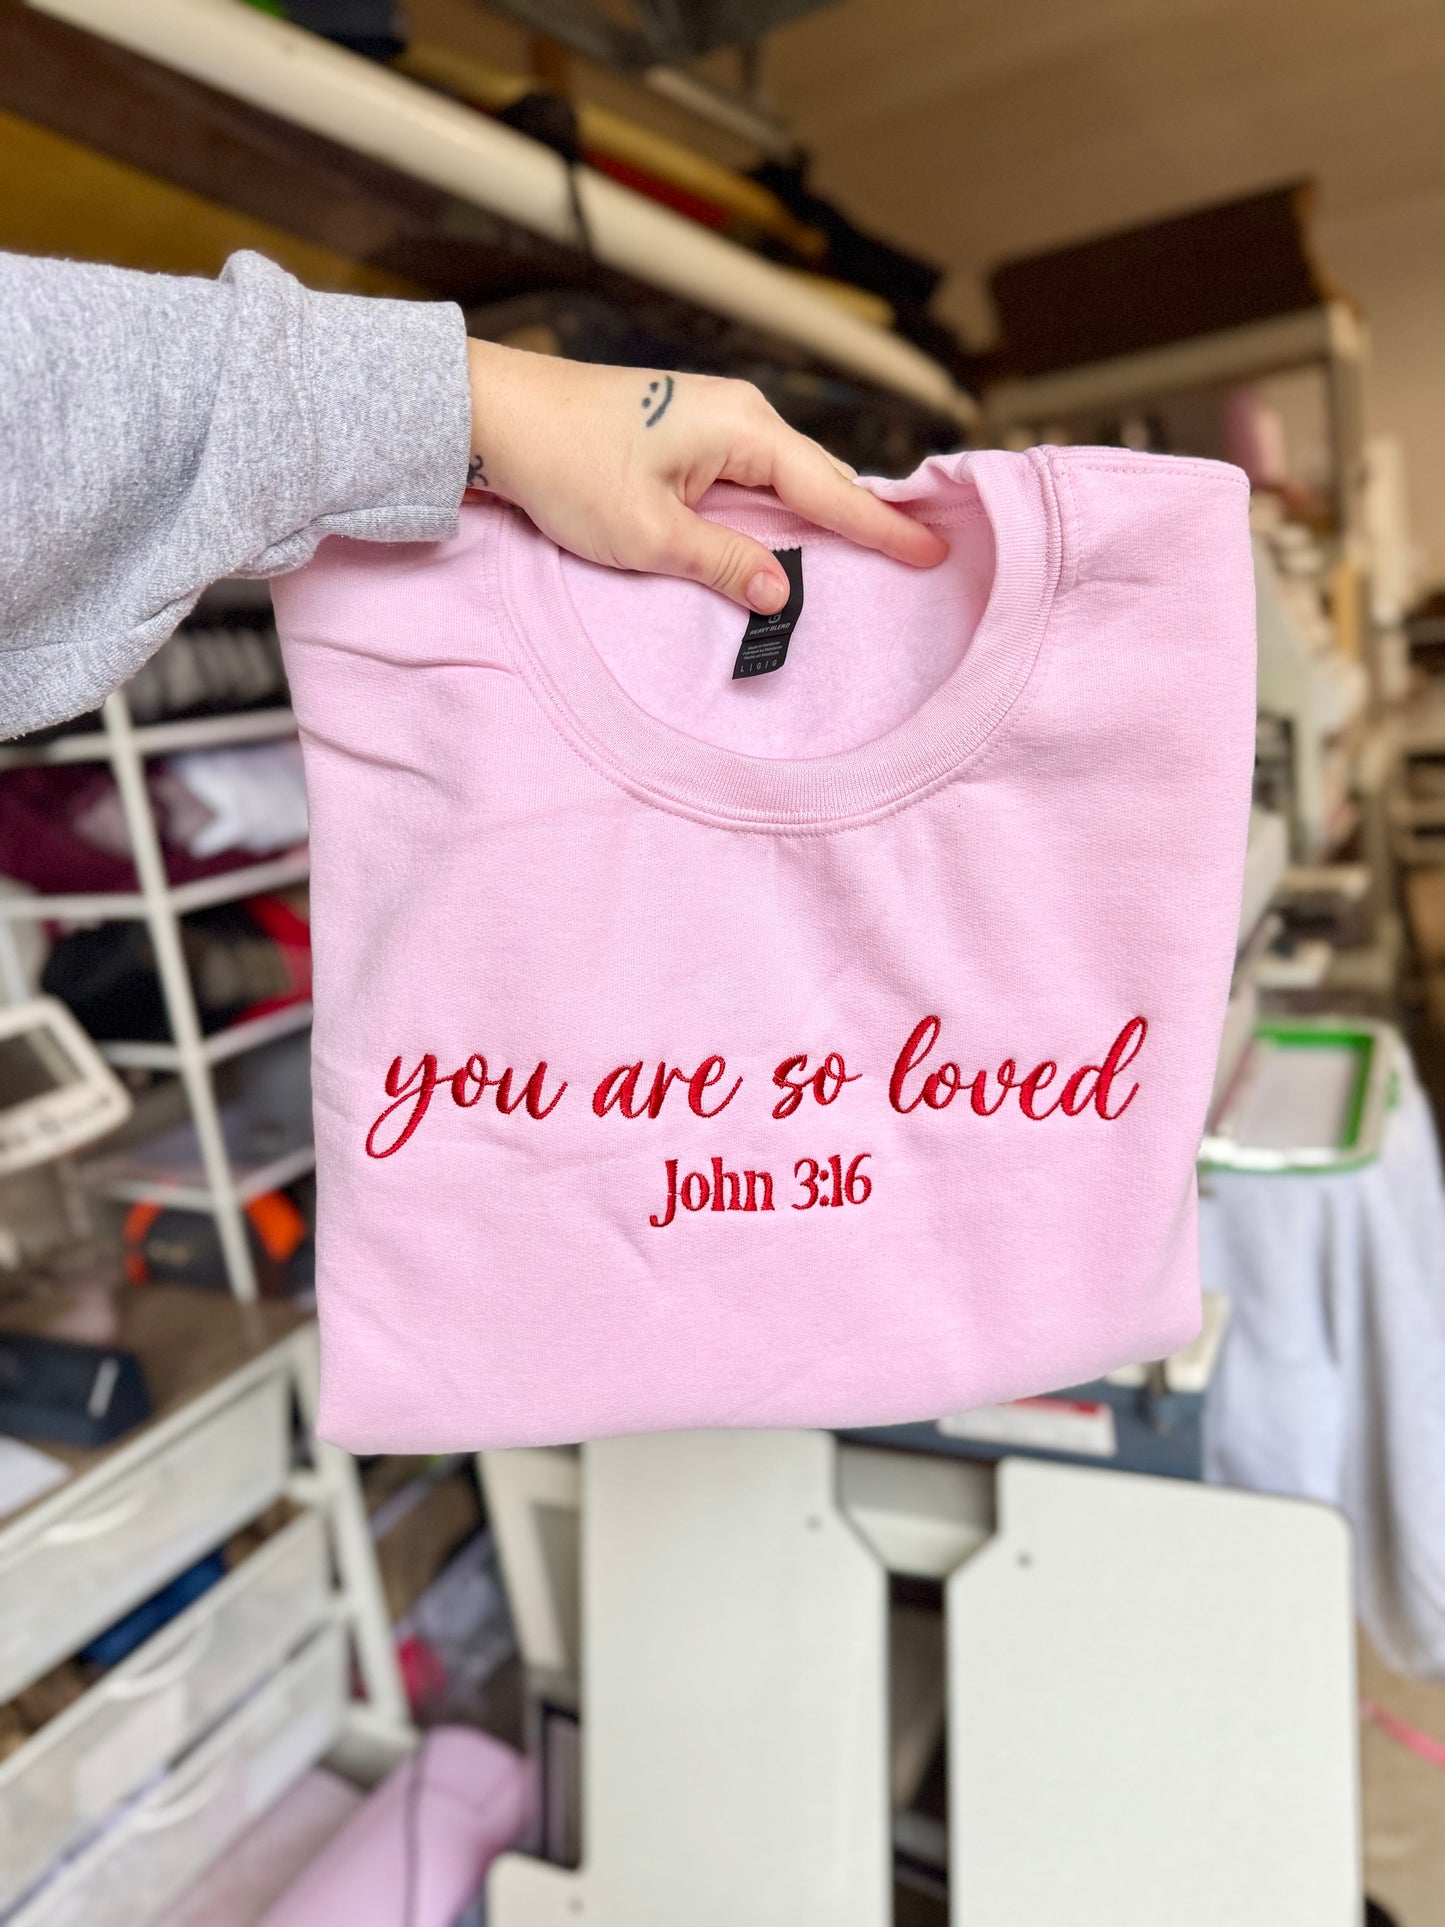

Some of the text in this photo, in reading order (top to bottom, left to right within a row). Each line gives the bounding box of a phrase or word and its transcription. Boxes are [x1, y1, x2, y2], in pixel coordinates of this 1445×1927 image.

[769, 622, 791, 632] BLEND
[364, 1014, 1148, 1160] you are so loved
[649, 1153, 872, 1228] John 3:16
